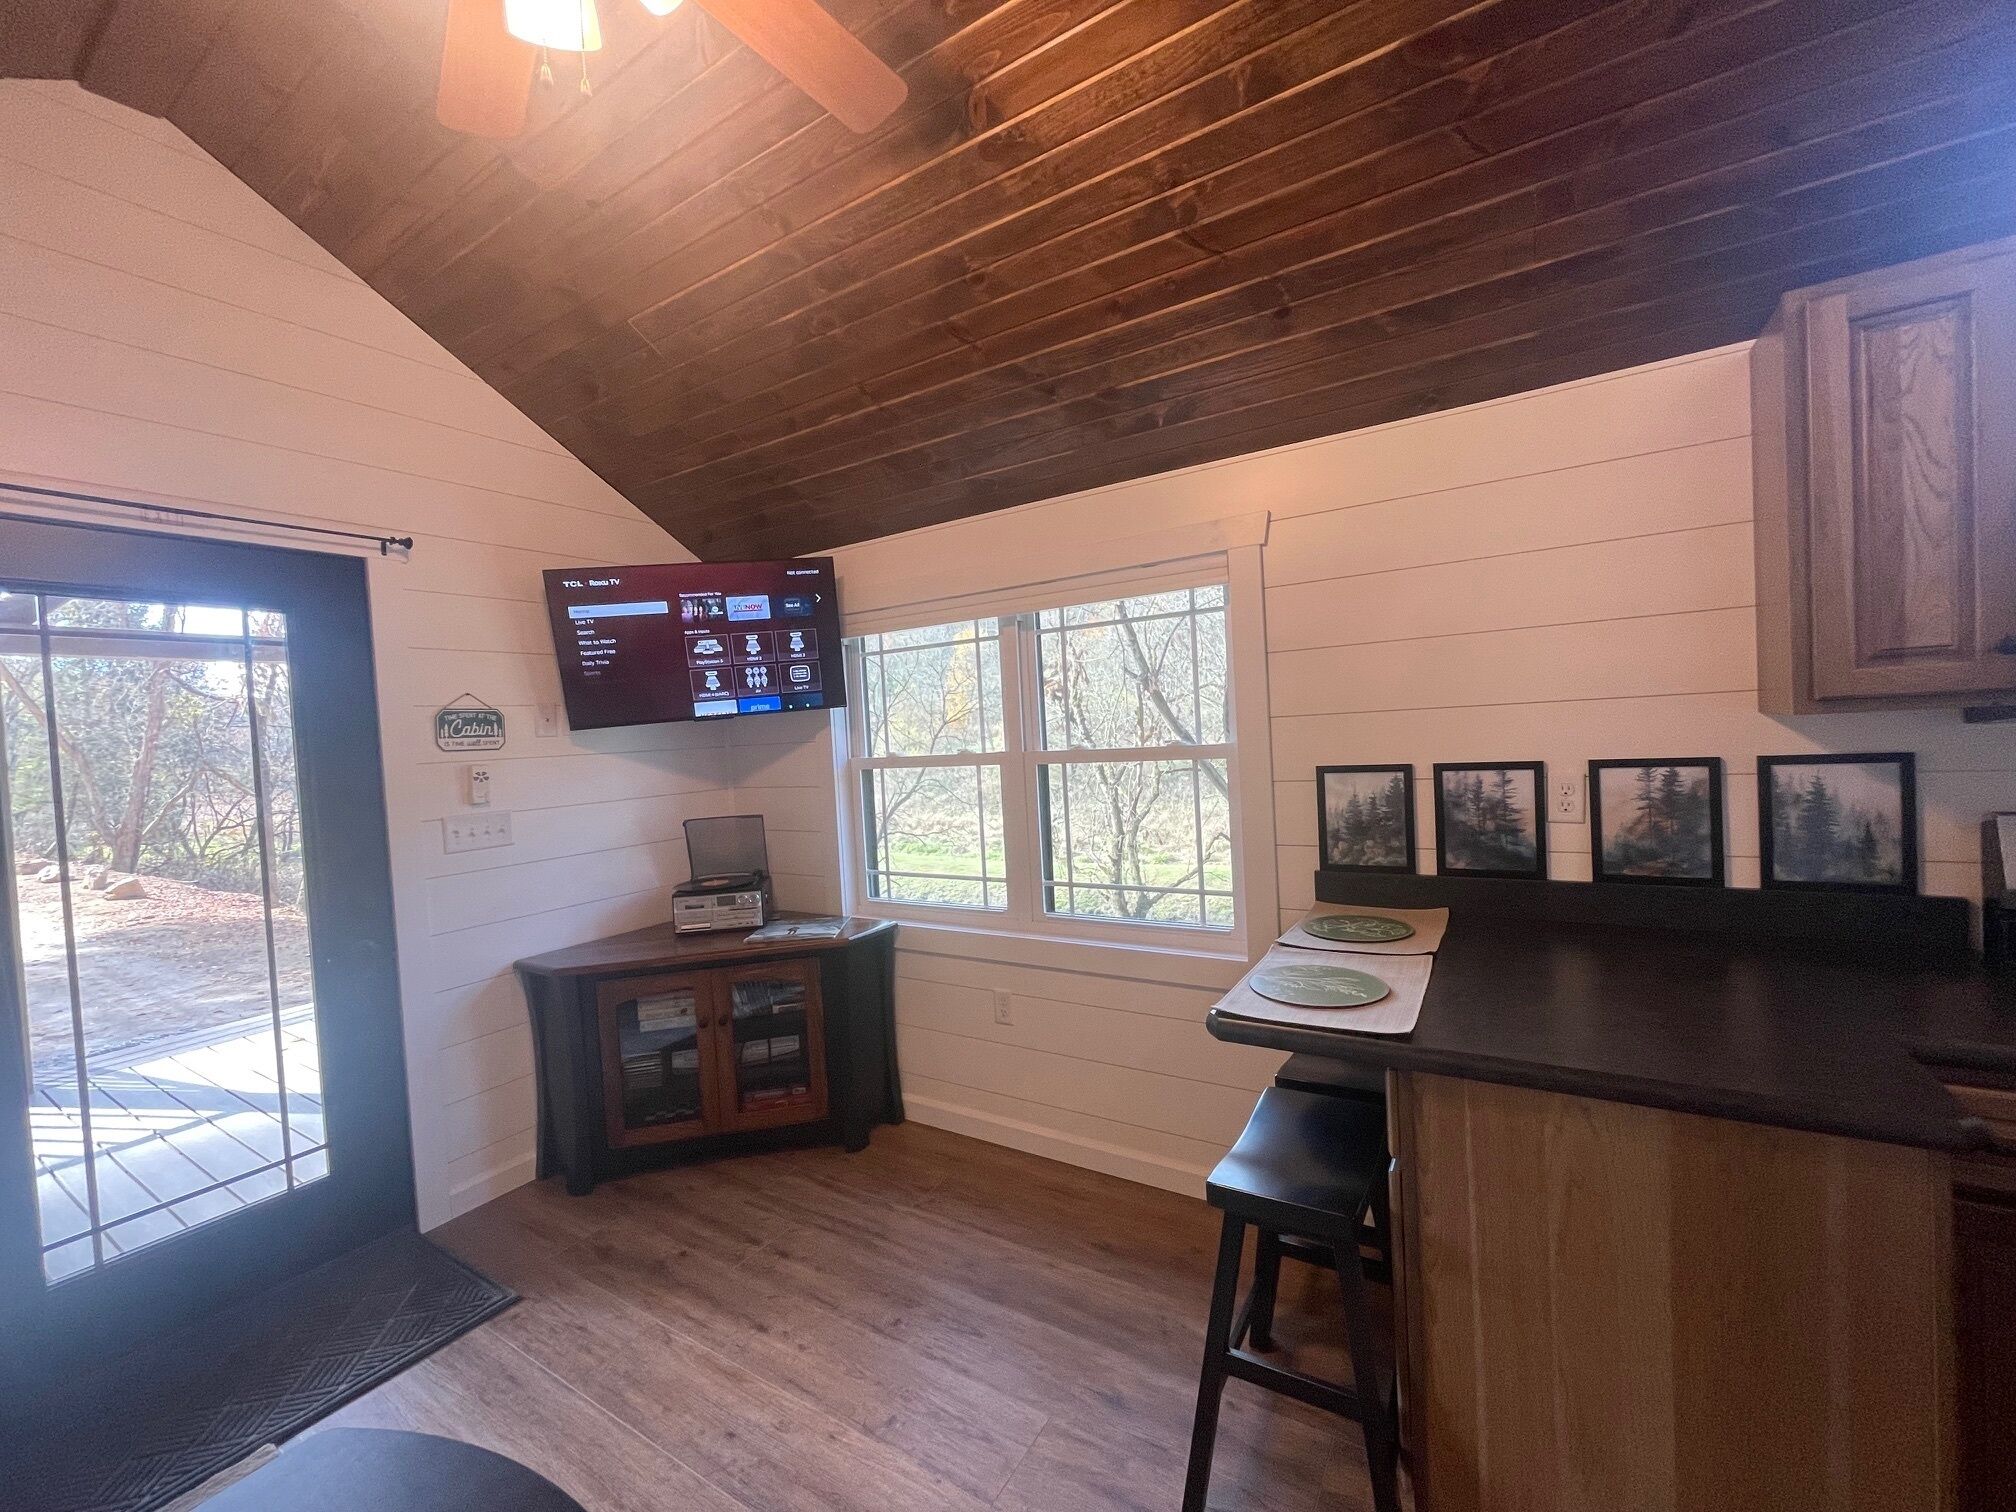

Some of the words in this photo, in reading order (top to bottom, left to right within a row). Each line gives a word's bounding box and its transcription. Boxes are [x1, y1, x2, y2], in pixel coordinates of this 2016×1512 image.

[562, 580, 584, 588] TCL
[588, 579, 609, 587] Roku
[609, 578, 620, 586] TV
[750, 703, 770, 711] prime
[450, 719, 493, 737] Cabin
